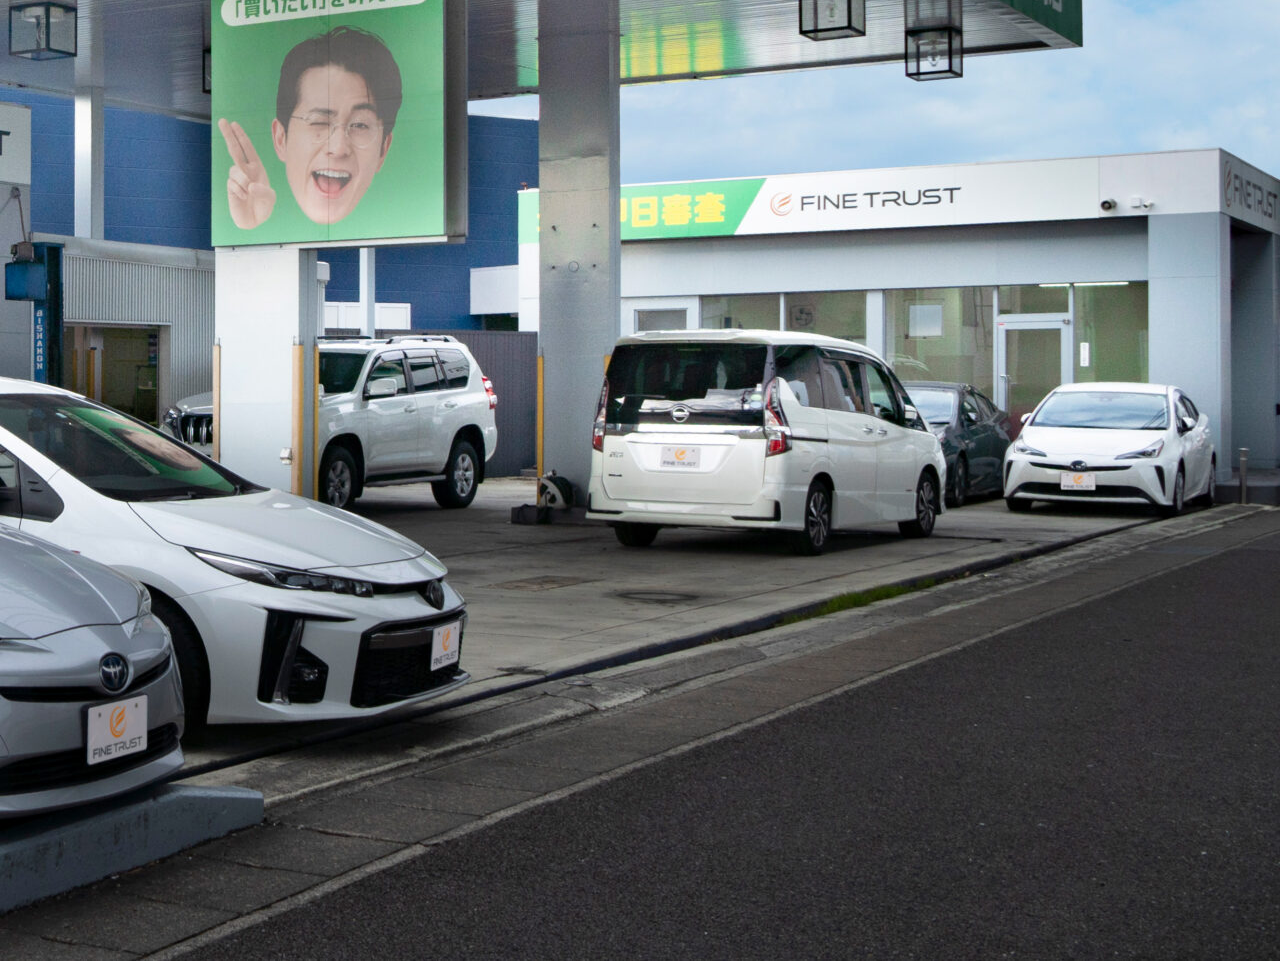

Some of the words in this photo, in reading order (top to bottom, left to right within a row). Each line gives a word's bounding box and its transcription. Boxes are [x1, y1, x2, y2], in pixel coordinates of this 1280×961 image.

[621, 191, 726, 228] 日審査
[801, 191, 859, 213] FINE
[863, 186, 962, 209] TRUST
[36, 309, 44, 370] BISHAMON
[93, 743, 113, 760] FINE
[113, 735, 143, 753] TRUST
